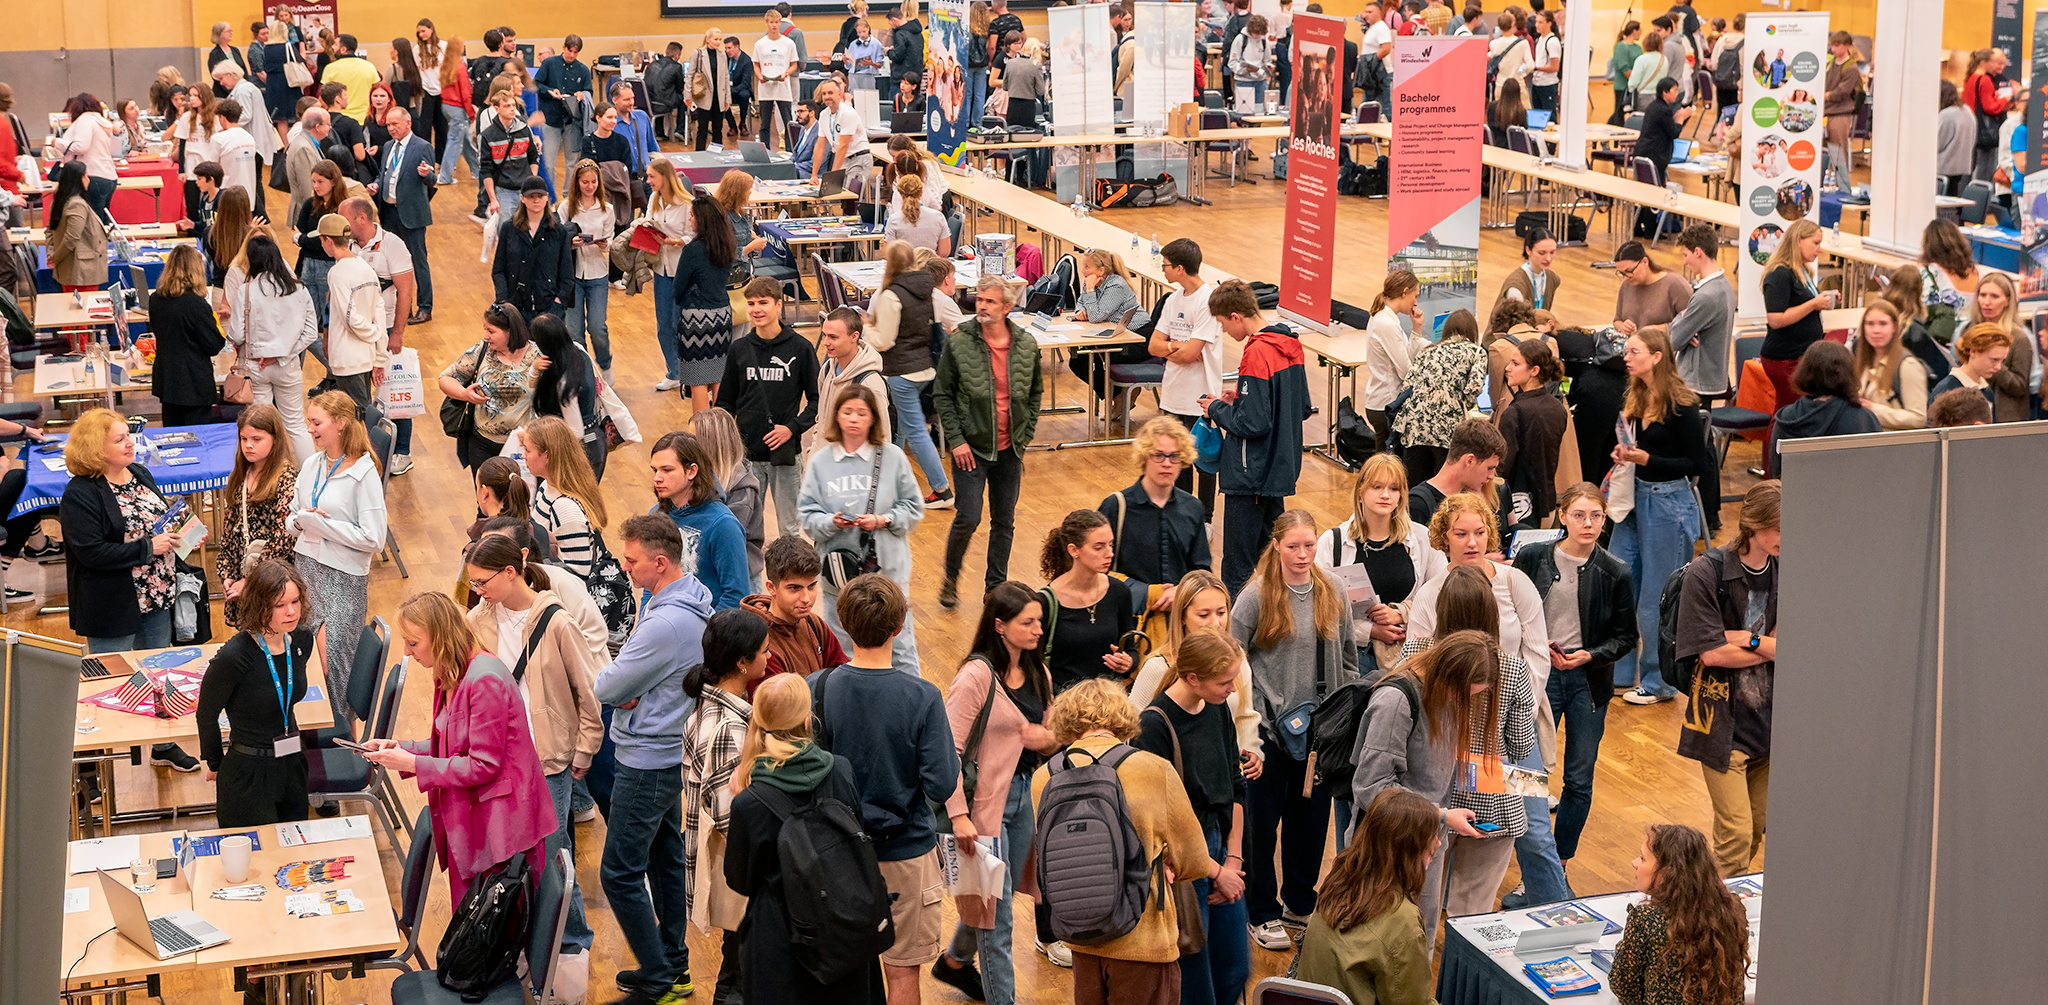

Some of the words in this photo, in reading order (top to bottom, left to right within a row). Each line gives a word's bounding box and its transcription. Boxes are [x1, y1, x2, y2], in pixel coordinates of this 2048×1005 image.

[1400, 93, 1440, 102] Bachelor
[1399, 105, 1456, 116] programmes
[1290, 131, 1305, 151] Les
[1305, 134, 1336, 160] Roches
